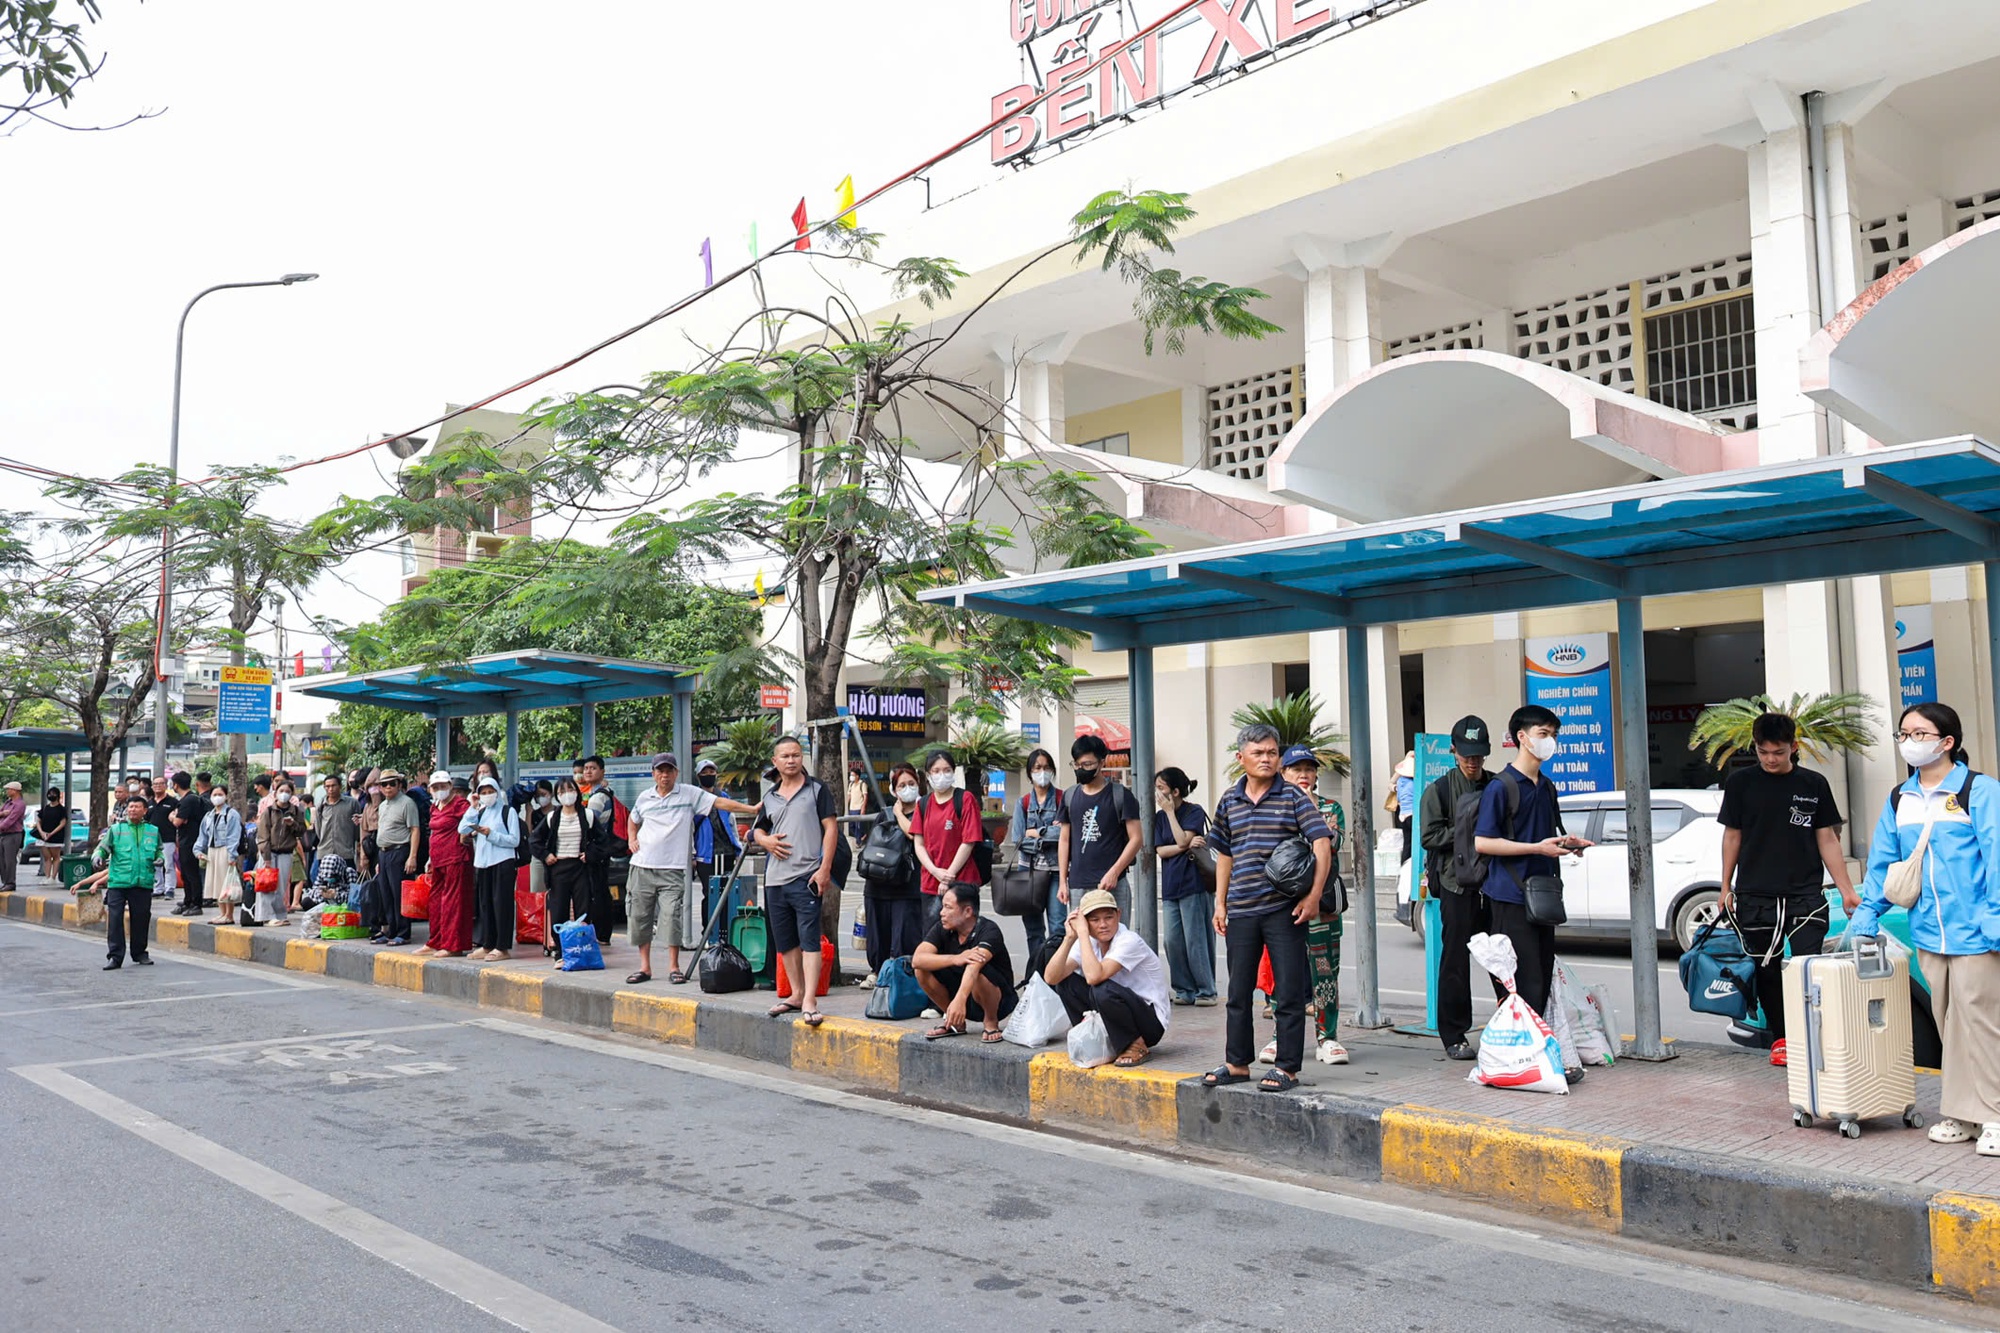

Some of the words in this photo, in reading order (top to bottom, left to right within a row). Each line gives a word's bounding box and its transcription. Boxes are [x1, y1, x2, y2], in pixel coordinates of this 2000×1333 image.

[991, 12, 1162, 166] BẾN
[1192, 0, 1336, 84] XE
[1555, 653, 1578, 661] HNB
[1904, 664, 1925, 678] VIÊN
[1537, 686, 1570, 699] NGHIÊM
[849, 690, 877, 715] HÀO
[879, 694, 925, 719] HƯƠNG
[1568, 704, 1592, 716] HÀNH
[1589, 721, 1602, 737] BỘ
[1569, 741, 1590, 756] TRẬT
[1552, 762, 1565, 773] AN
[1566, 759, 1589, 773] TOÀN
[1567, 779, 1596, 792] THÔNG
[1710, 979, 1734, 992] NIKE
